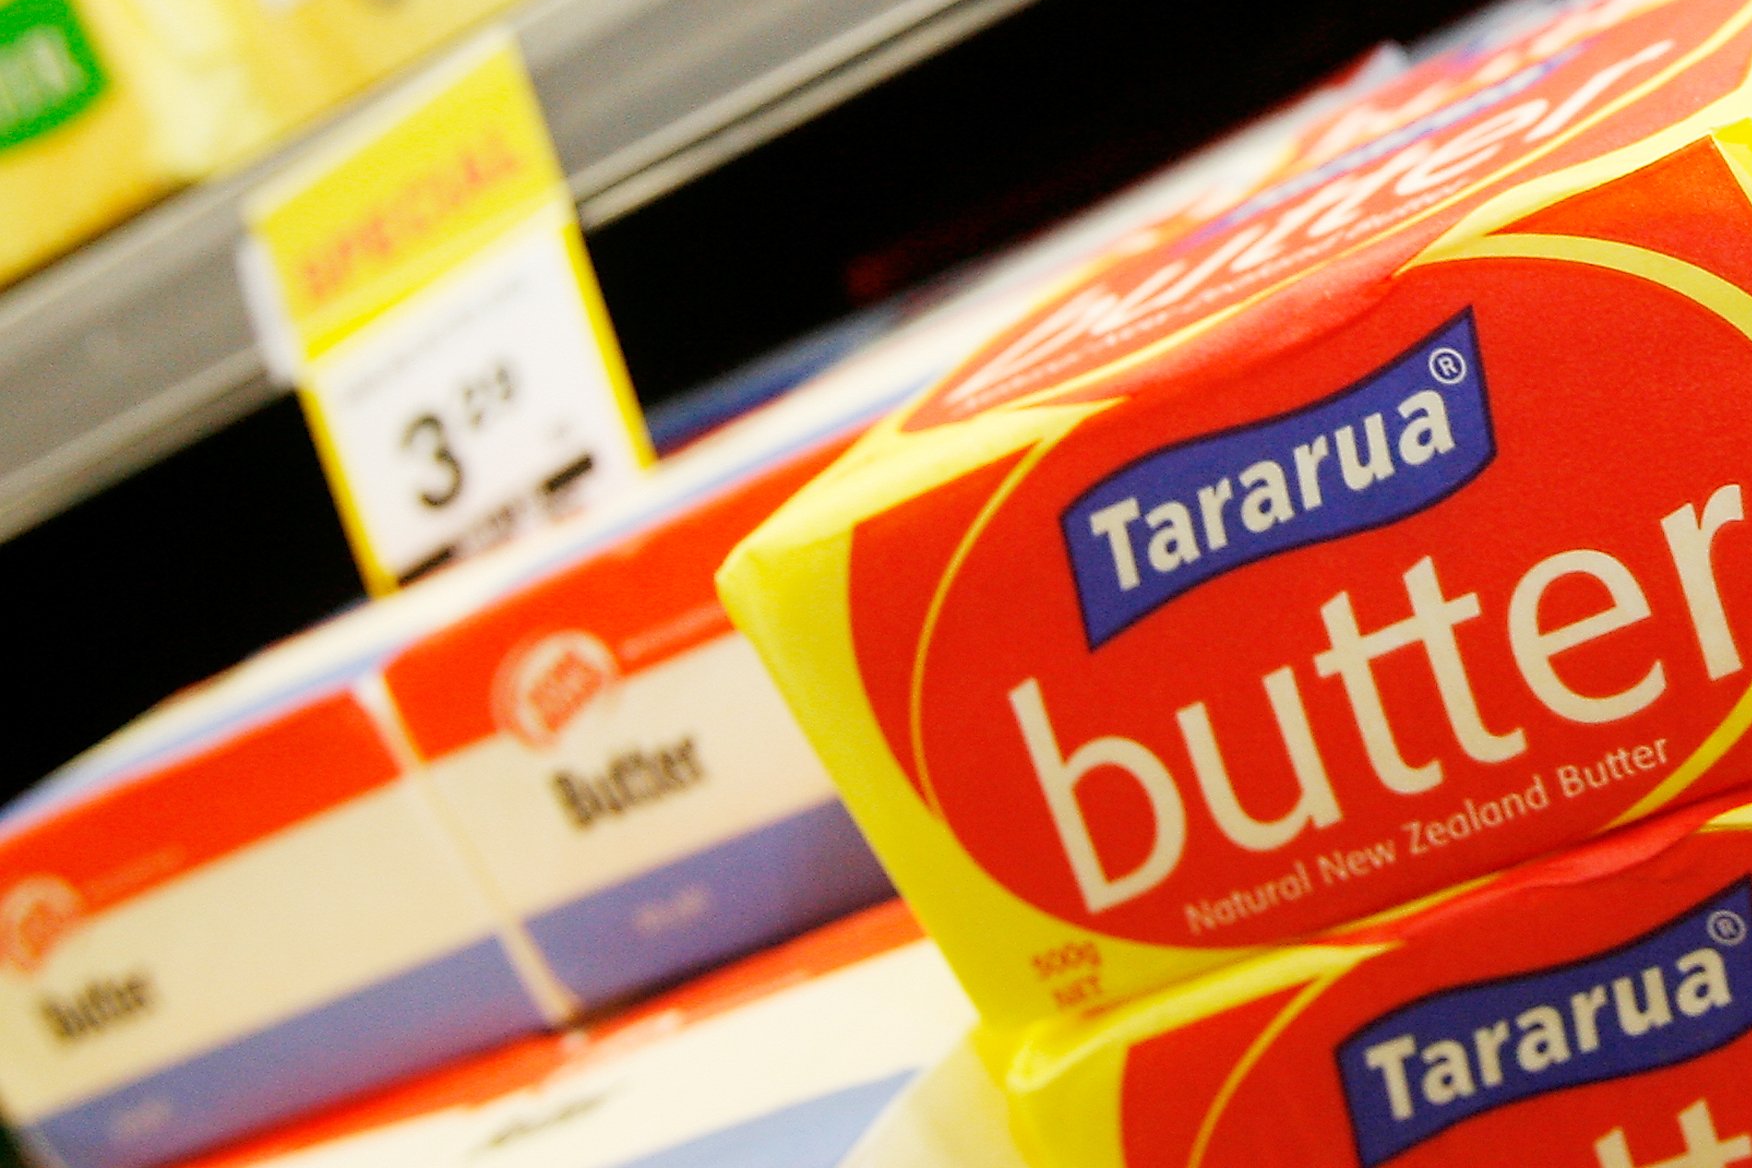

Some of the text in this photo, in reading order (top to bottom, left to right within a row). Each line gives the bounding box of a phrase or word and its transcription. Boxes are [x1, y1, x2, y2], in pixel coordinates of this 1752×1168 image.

[400, 409, 463, 510] 3
[1011, 483, 1746, 914] butter
[1186, 733, 1670, 936] Natural New Zealand Butter
